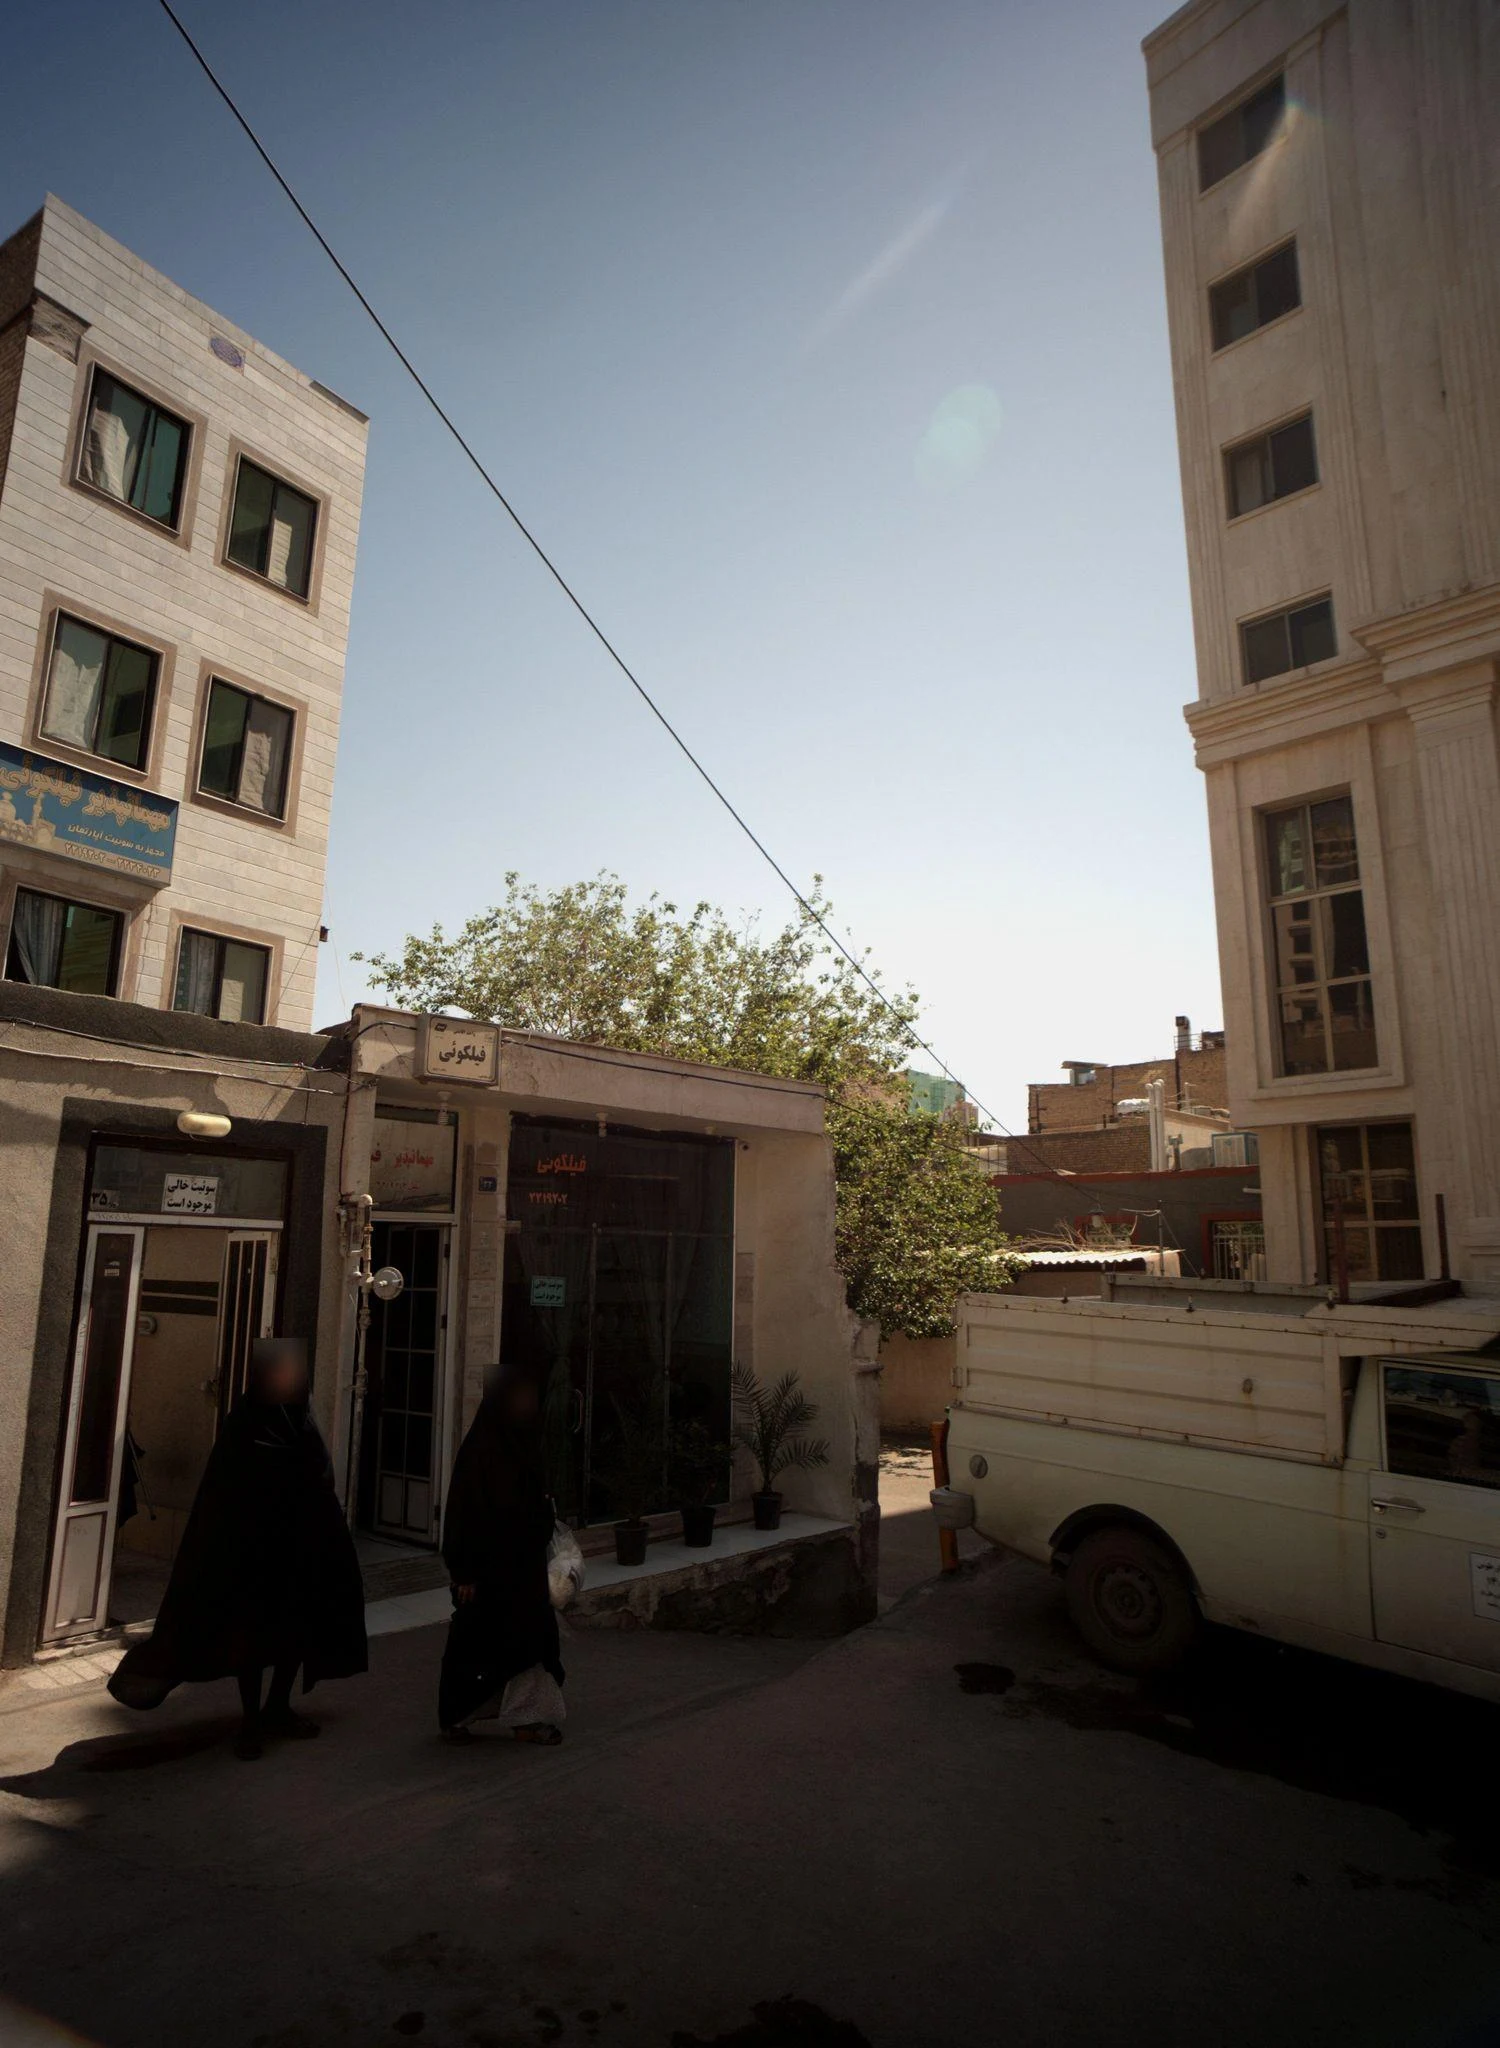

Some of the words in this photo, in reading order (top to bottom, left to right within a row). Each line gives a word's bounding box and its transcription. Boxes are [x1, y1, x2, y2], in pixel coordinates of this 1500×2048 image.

[438, 1039, 487, 1066] فیلگوئی
[167, 1178, 189, 1193] خالی
[166, 1197, 186, 1208] است
[187, 1199, 213, 1213] موجود
